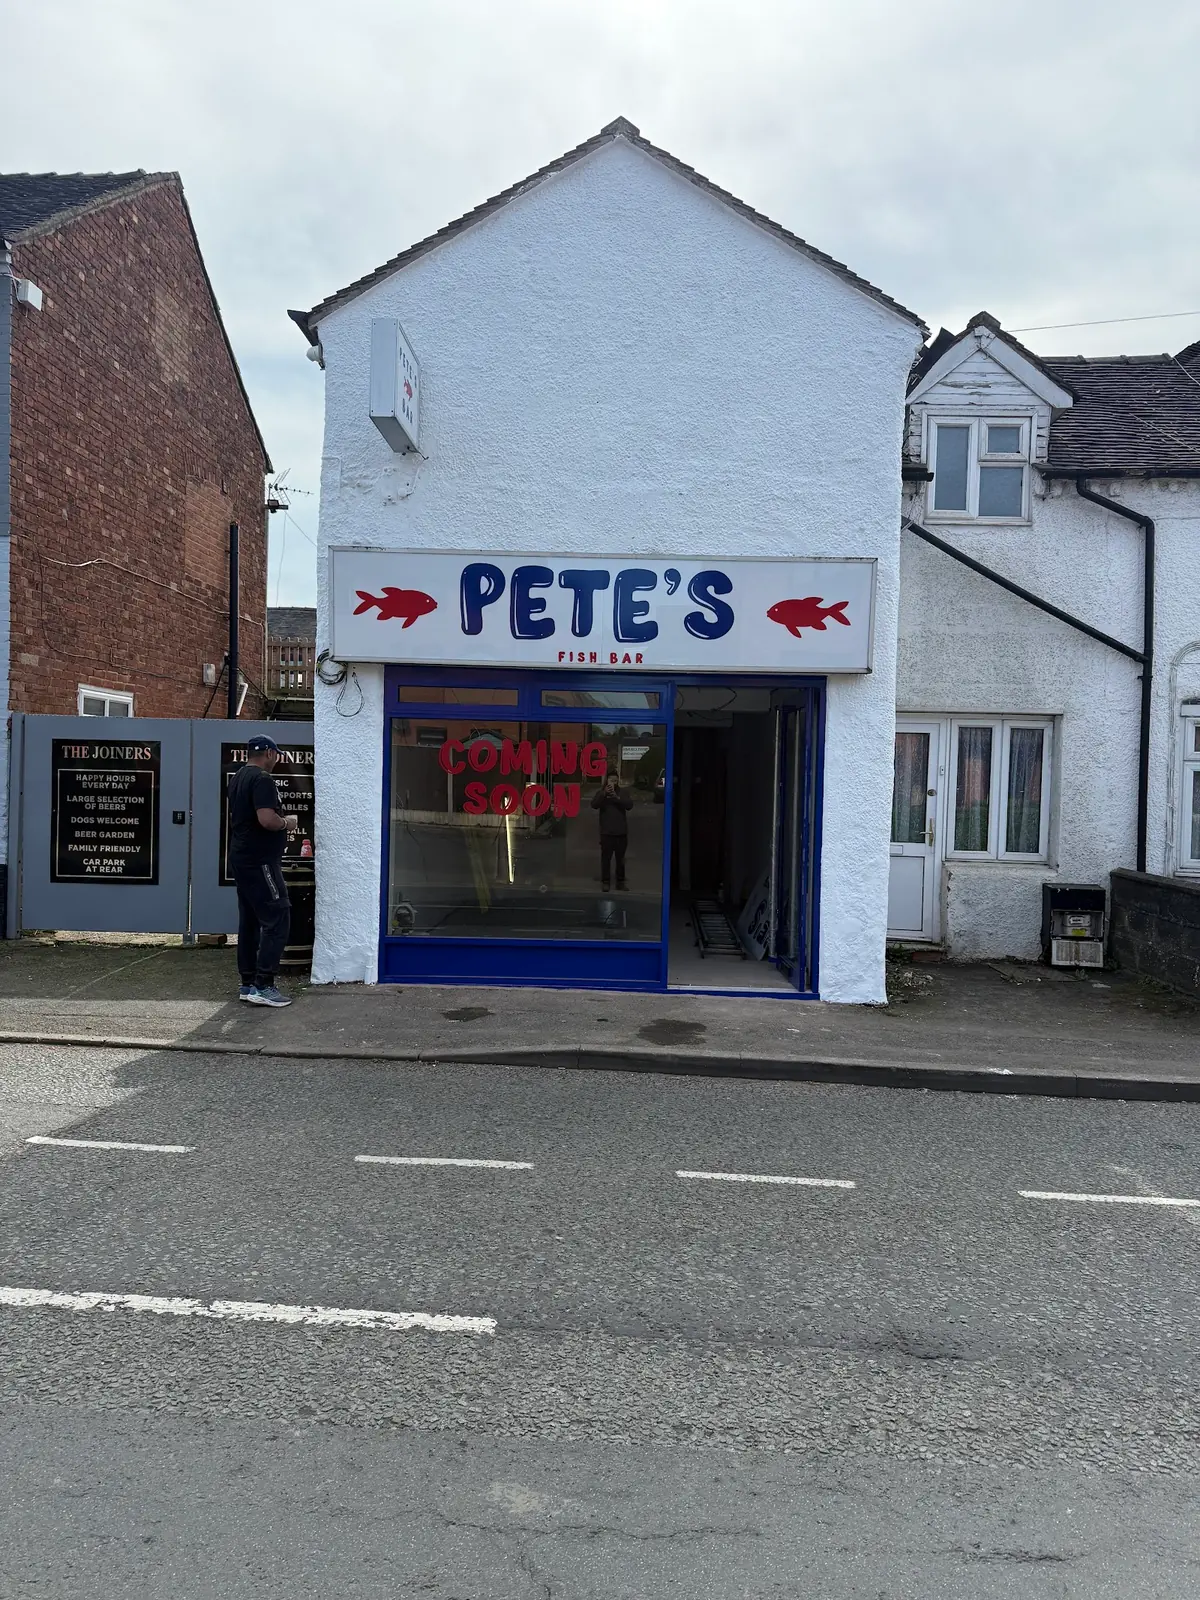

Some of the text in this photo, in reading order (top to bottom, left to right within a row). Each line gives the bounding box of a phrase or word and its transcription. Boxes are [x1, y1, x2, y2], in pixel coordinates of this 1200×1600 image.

[460, 562, 735, 643] PETE'S
[558, 651, 644, 664] FISH BAR
[62, 745, 152, 760] THE JOINERS
[231, 749, 249, 763] TH
[438, 739, 608, 777] COMING
[76, 774, 136, 783] HAPPY HOURS
[111, 782, 129, 790] DAY
[66, 795, 145, 804] LARGE SELECTION
[463, 781, 581, 818] SOON
[98, 803, 126, 811] BEERS
[70, 816, 140, 825] DOGS WELCOME
[99, 831, 135, 839] GARDEN
[68, 844, 141, 853] FAMILY FRIENDLY
[83, 858, 126, 867] CAR PARK
[99, 866, 123, 874] REAR
